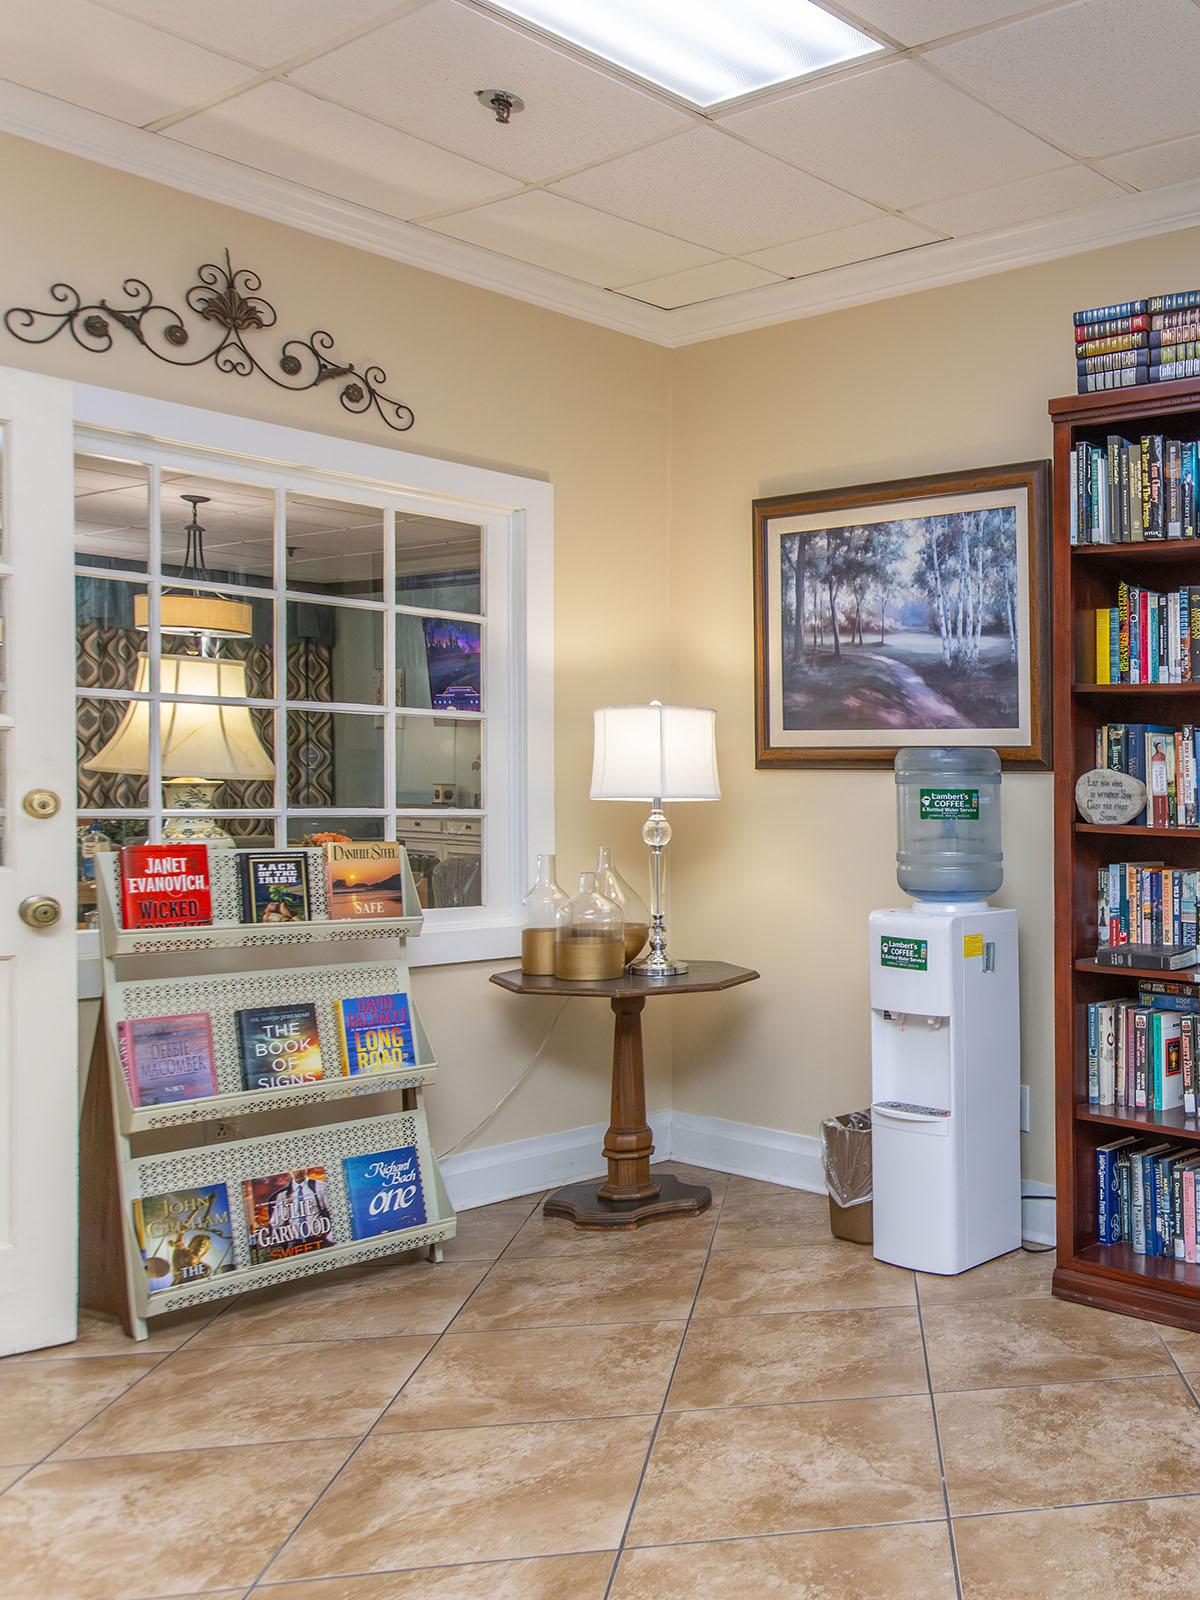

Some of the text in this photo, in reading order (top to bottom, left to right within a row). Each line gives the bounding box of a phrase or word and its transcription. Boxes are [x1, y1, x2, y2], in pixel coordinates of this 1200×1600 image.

[1142, 454, 1150, 471] Bear
[1142, 473, 1150, 485] and
[1151, 463, 1160, 503] Tom Clancy
[1180, 611, 1188, 639] HIGGINS
[333, 844, 398, 860] DANIELLE STEEL
[144, 857, 187, 874] JANET
[127, 874, 206, 894] EVANOVICH
[259, 876, 297, 884] IRISH
[138, 900, 198, 919] WICKED
[354, 901, 384, 914] SAFE
[888, 940, 918, 950] Lambert's
[890, 948, 914, 957] COFFEE
[357, 996, 395, 1013] DAVID
[347, 1009, 407, 1028] BALDACCI
[262, 1023, 300, 1038] THE
[355, 1028, 404, 1052] LONG
[151, 1040, 190, 1059] DEBBIE
[255, 1038, 311, 1057] BOOK
[142, 1055, 208, 1077] MACOMBER
[272, 1057, 299, 1071] OF
[358, 1048, 403, 1073] ROAD
[1182, 1033, 1192, 1086] LIBERTY FALLING
[258, 1073, 316, 1089] SIGNS
[364, 1157, 412, 1178] Richard
[382, 1172, 416, 1187] Bach
[163, 1196, 210, 1217] JOHN
[369, 1185, 417, 1216] one
[273, 1198, 315, 1227] JULIE
[147, 1211, 229, 1238] GRISHAM
[258, 1216, 330, 1247] GARWOOD
[271, 1240, 323, 1260] SWEET
[181, 1264, 205, 1278] THE
